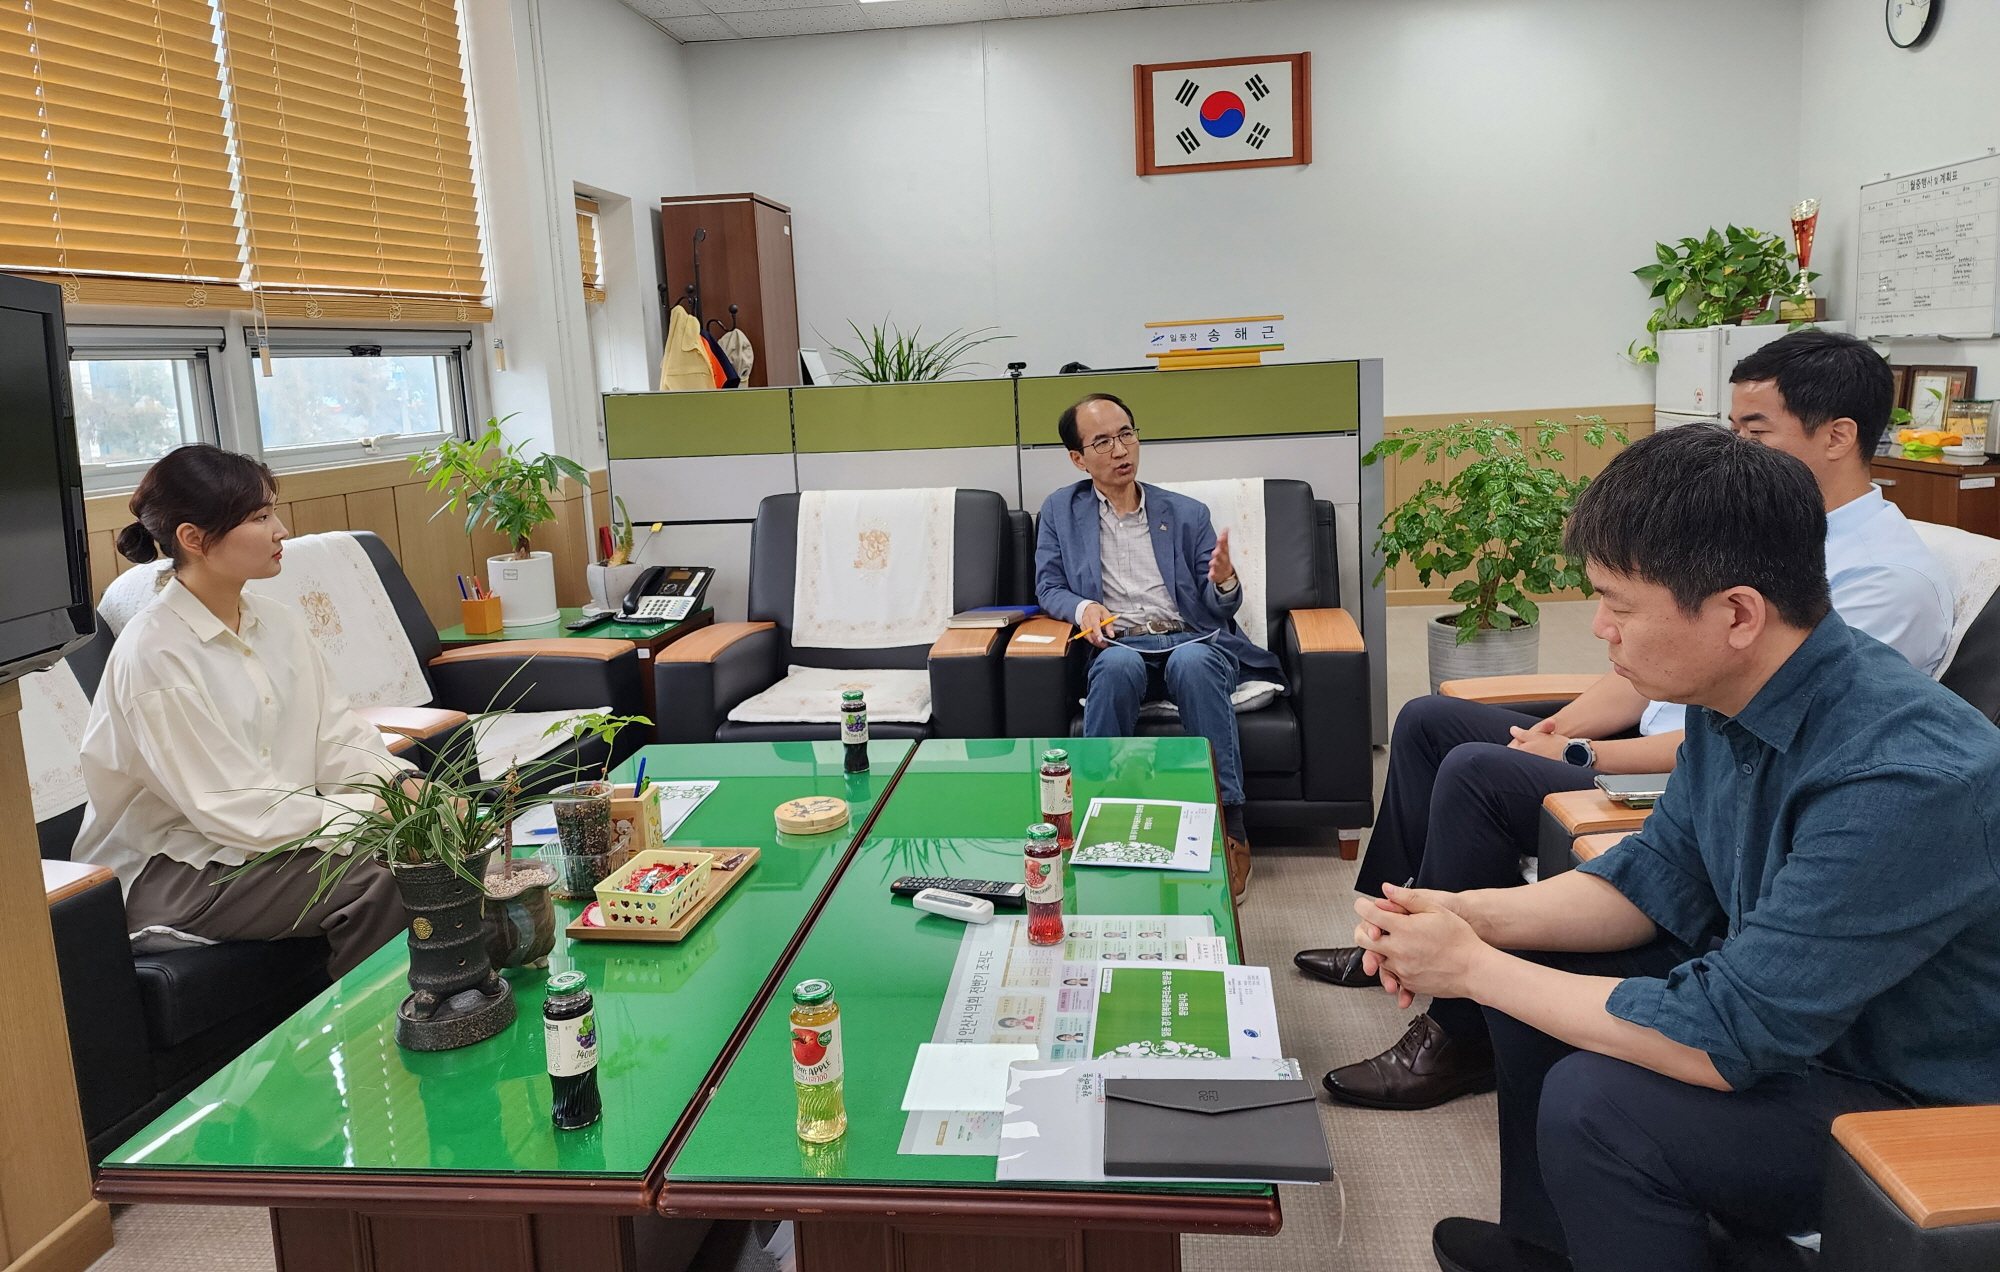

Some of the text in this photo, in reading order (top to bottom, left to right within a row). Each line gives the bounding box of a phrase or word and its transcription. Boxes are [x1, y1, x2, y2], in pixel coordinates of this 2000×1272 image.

[1169, 332, 1197, 342] 일동장
[975, 950, 994, 970] 조직도
[969, 972, 989, 994] 전반기
[957, 996, 984, 1036] 안산시의회
[808, 1058, 831, 1076] APPLE
